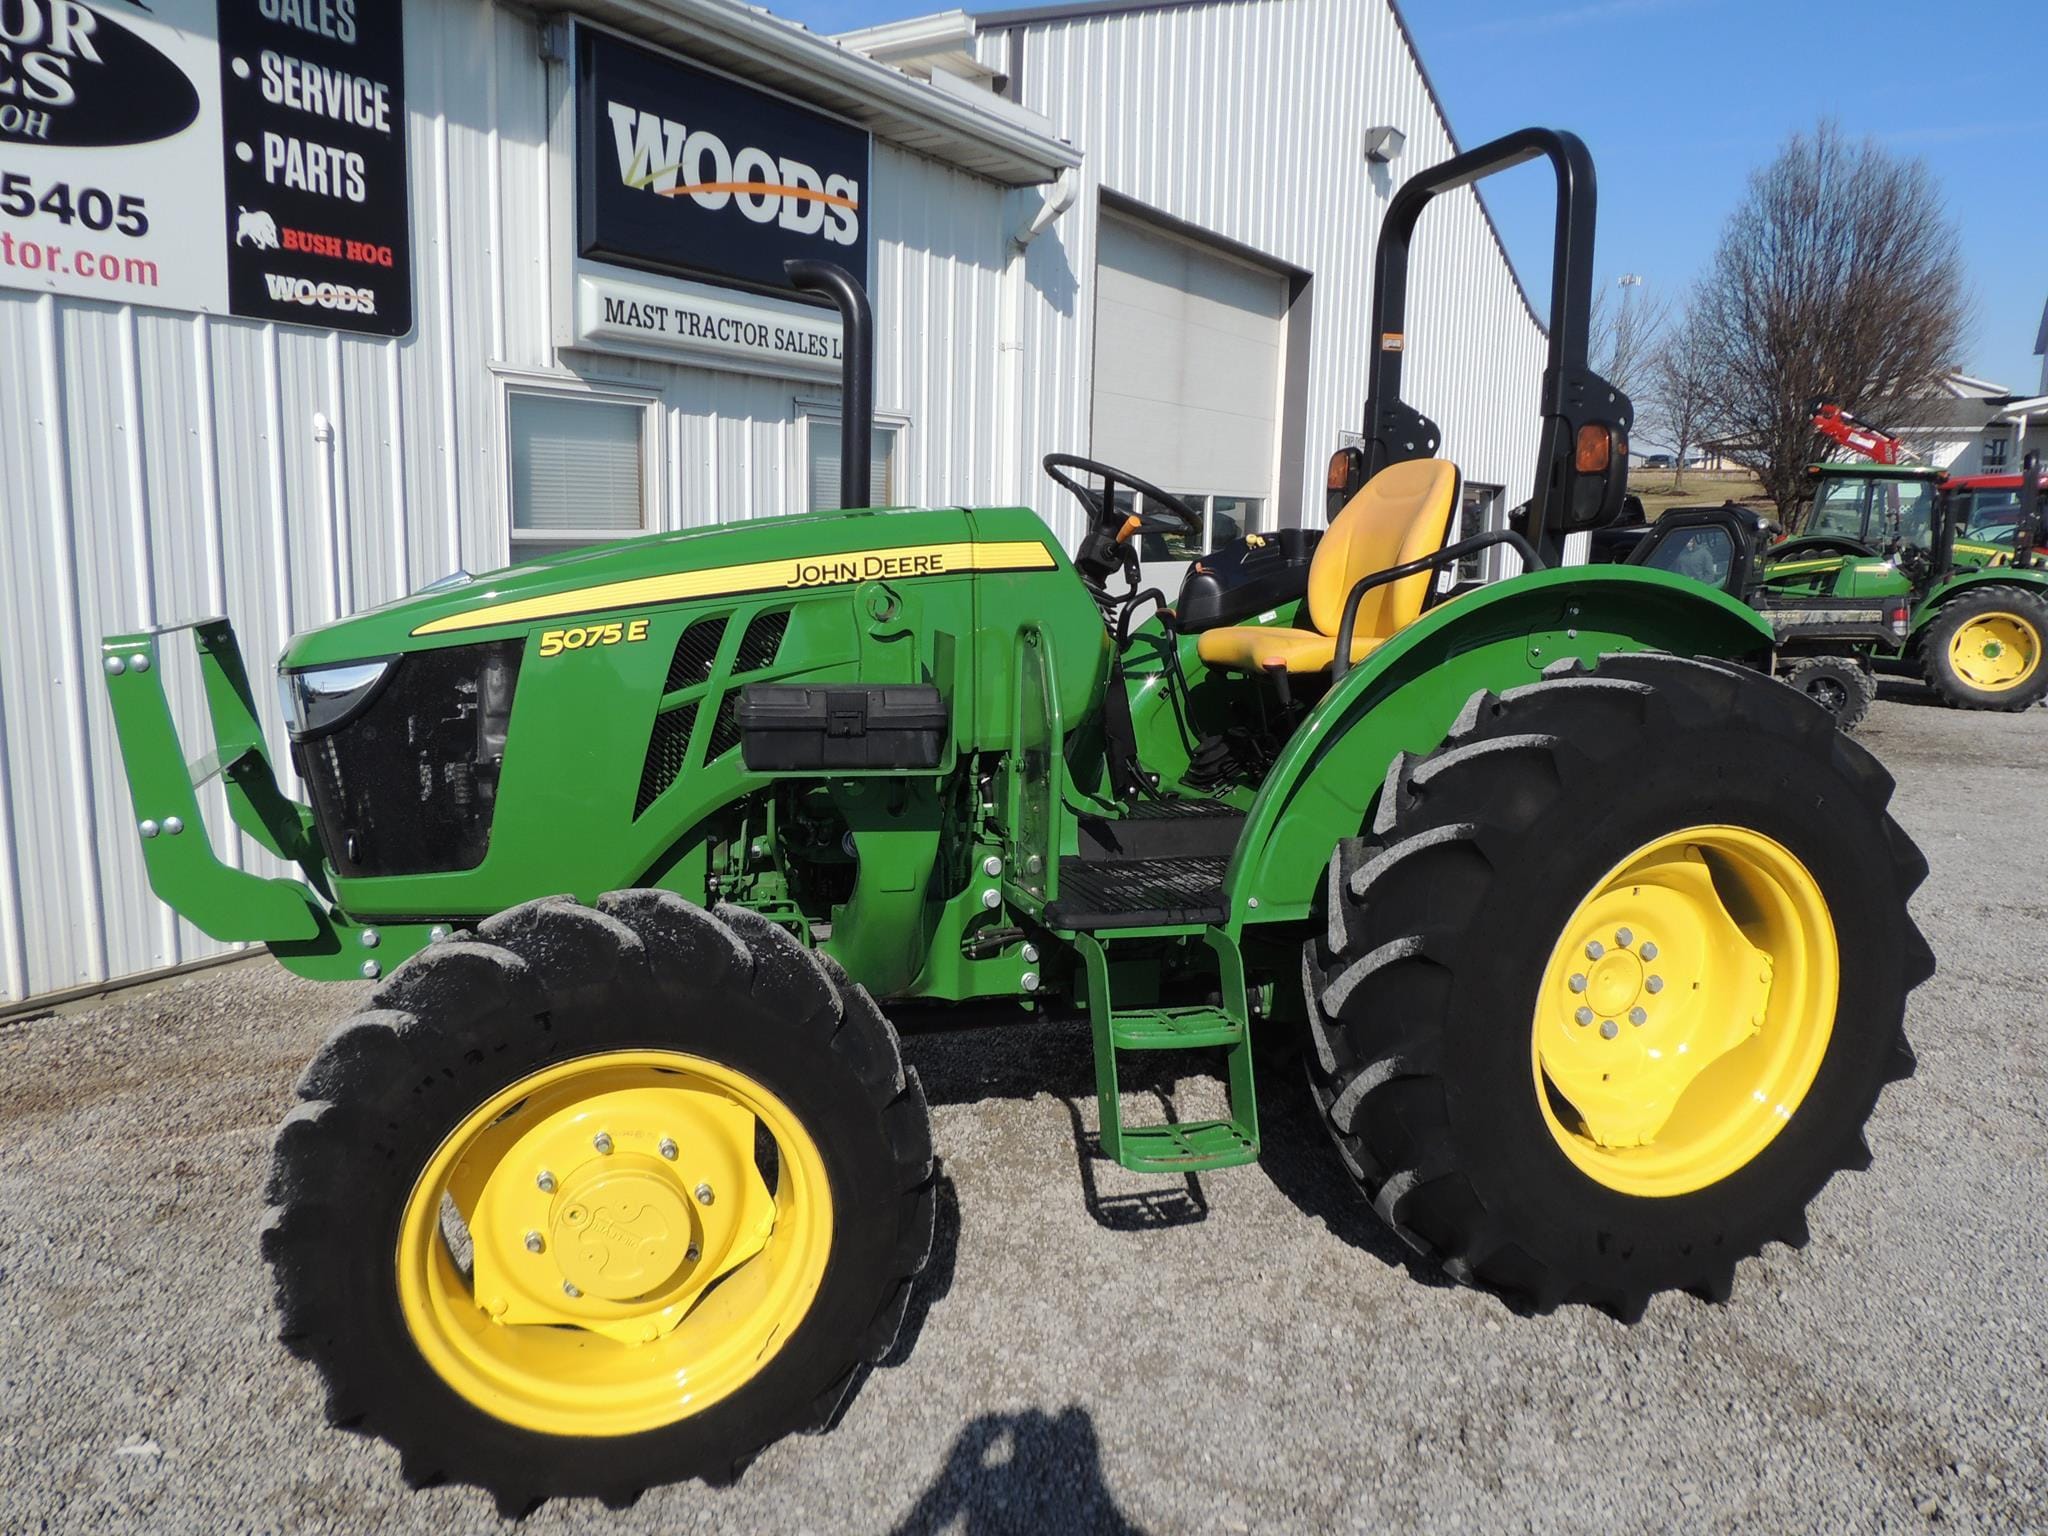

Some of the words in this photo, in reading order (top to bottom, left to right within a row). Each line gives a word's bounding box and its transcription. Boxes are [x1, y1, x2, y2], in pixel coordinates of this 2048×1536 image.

[261, 50, 391, 133] SERVICE
[0, 104, 51, 139] OH
[264, 131, 366, 202] PARTS
[608, 100, 859, 246] WOODS
[0, 171, 149, 238] 5405
[282, 228, 343, 259] BUSH
[346, 240, 393, 268] HOG
[264, 273, 376, 315] WOODS
[605, 297, 668, 332] MAST
[675, 310, 770, 348] TRACTOR
[774, 328, 828, 357] SALES
[787, 562, 857, 585] JOHN
[864, 554, 943, 577] DEERE
[540, 623, 623, 656] 5075
[627, 620, 649, 642] E
